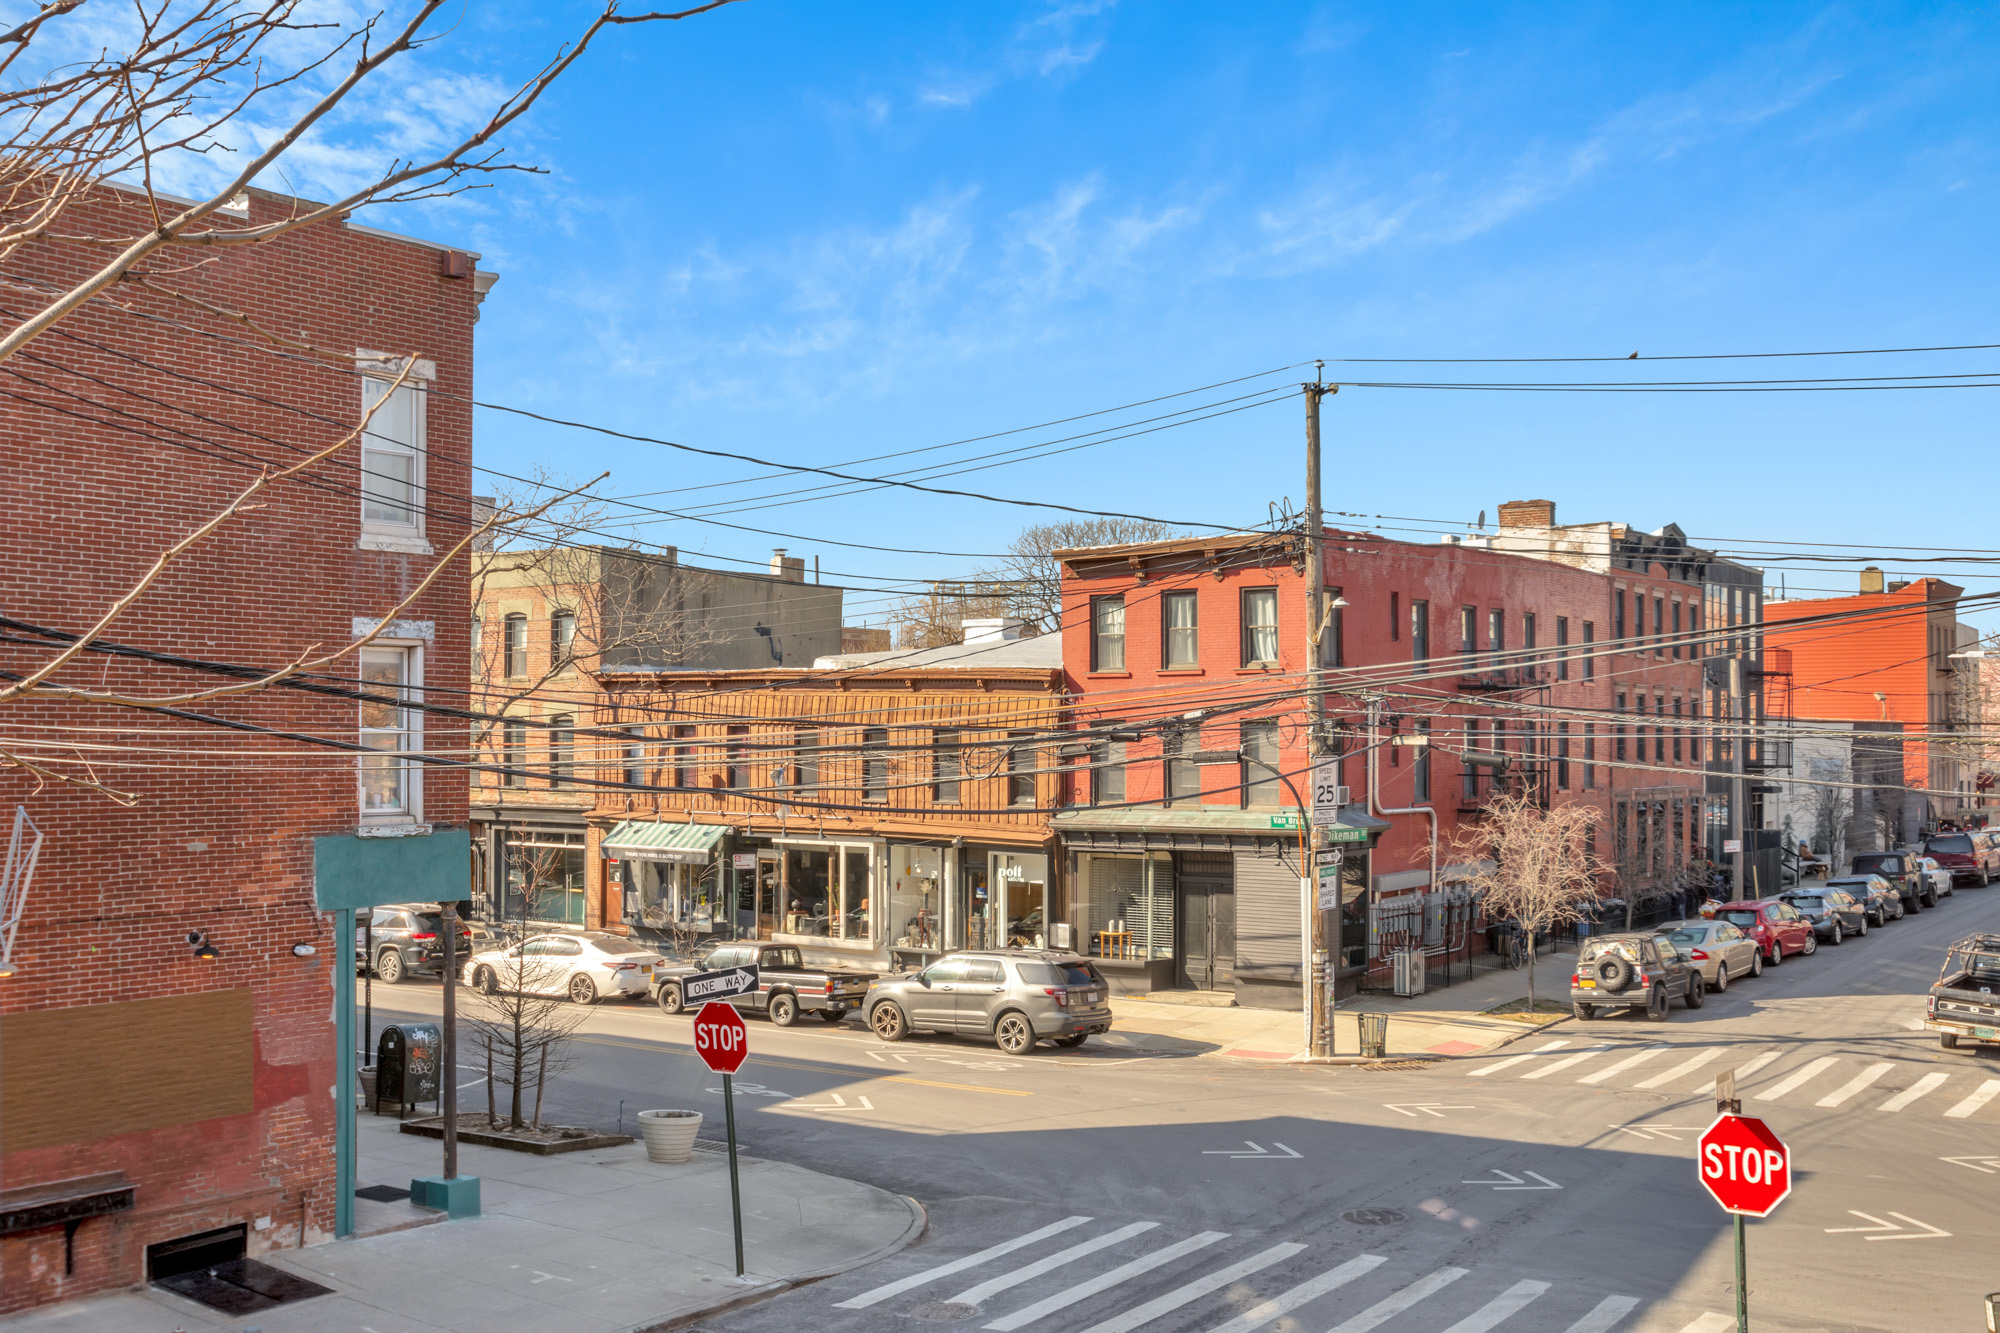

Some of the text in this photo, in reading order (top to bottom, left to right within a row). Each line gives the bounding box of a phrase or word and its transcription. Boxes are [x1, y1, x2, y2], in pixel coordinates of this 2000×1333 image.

[1317, 784, 1334, 803] 25
[1273, 816, 1286, 824] Van
[1319, 889, 1334, 899] SHARED
[1321, 898, 1332, 906] LANE
[693, 974, 747, 995] ONE WAY
[697, 1022, 744, 1052] STOP
[1704, 1142, 1784, 1186] STOP
